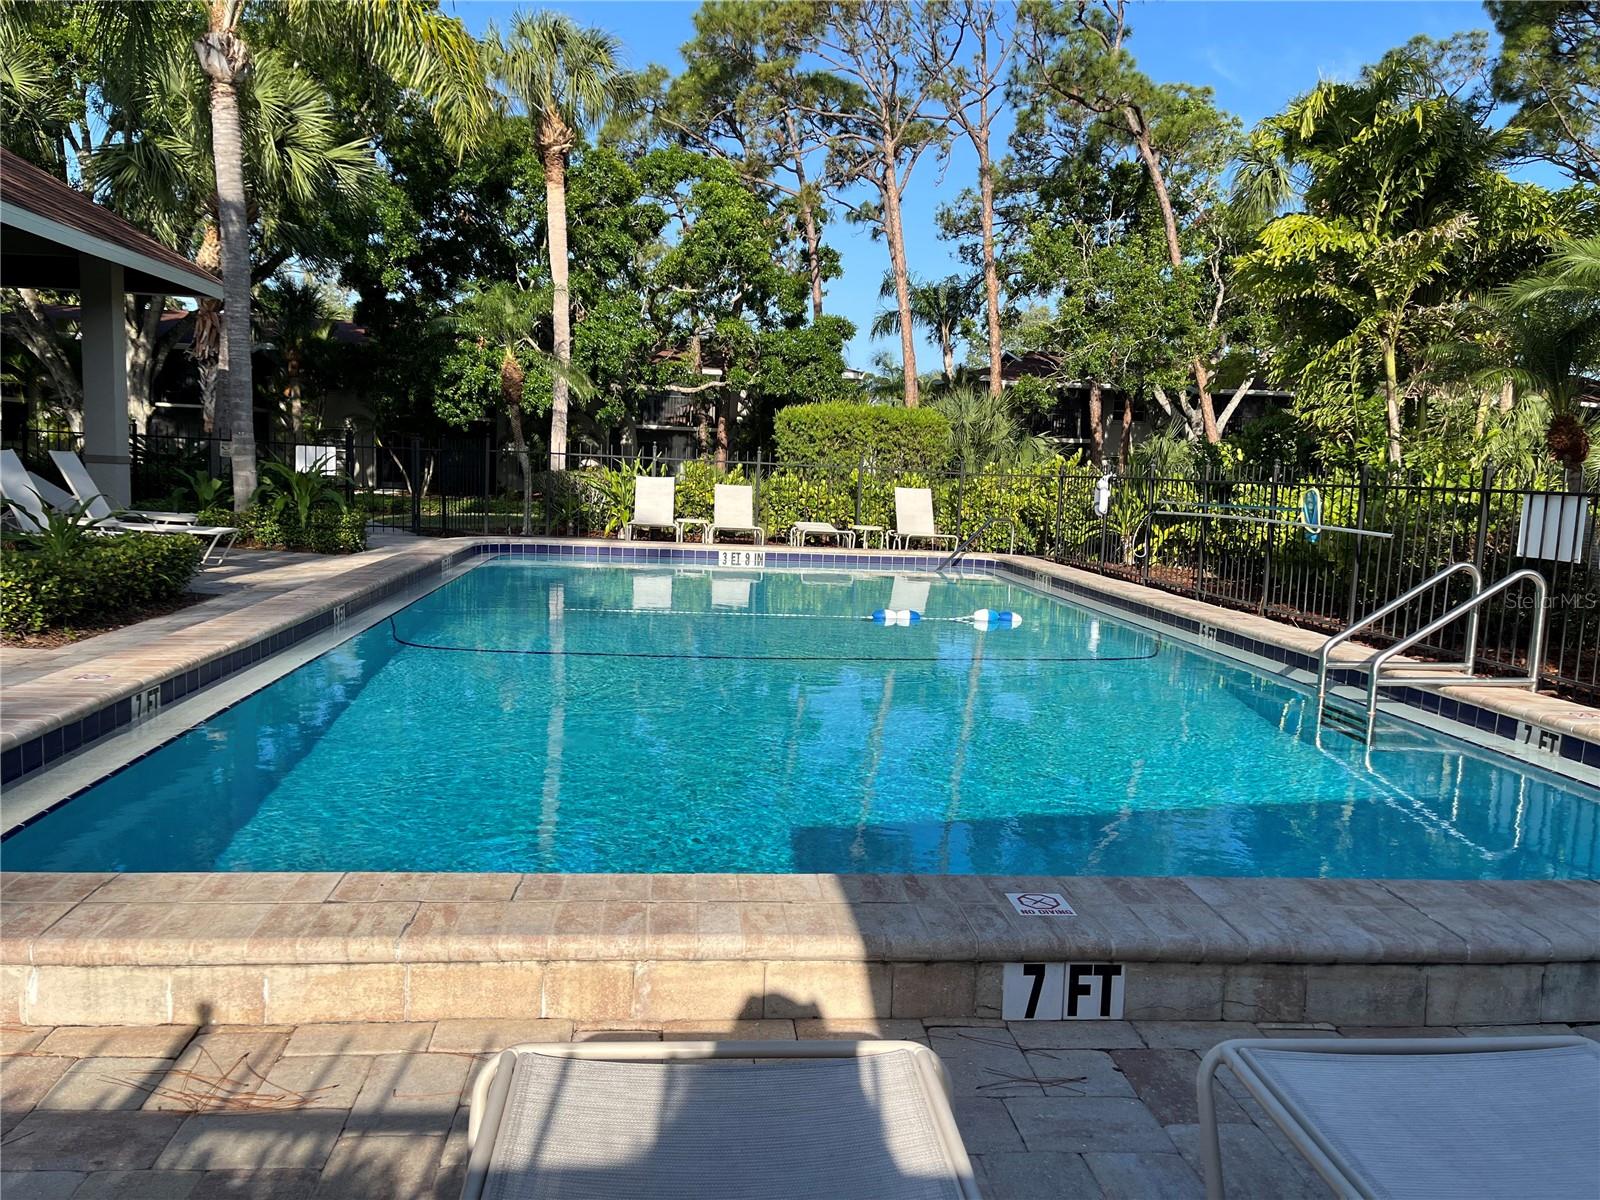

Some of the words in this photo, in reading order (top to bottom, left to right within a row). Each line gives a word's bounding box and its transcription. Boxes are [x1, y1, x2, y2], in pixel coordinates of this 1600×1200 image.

[1524, 723, 1532, 745] 7
[1538, 729, 1559, 753] FT
[1023, 963, 1046, 1019] 7
[1067, 964, 1122, 1017] FT
